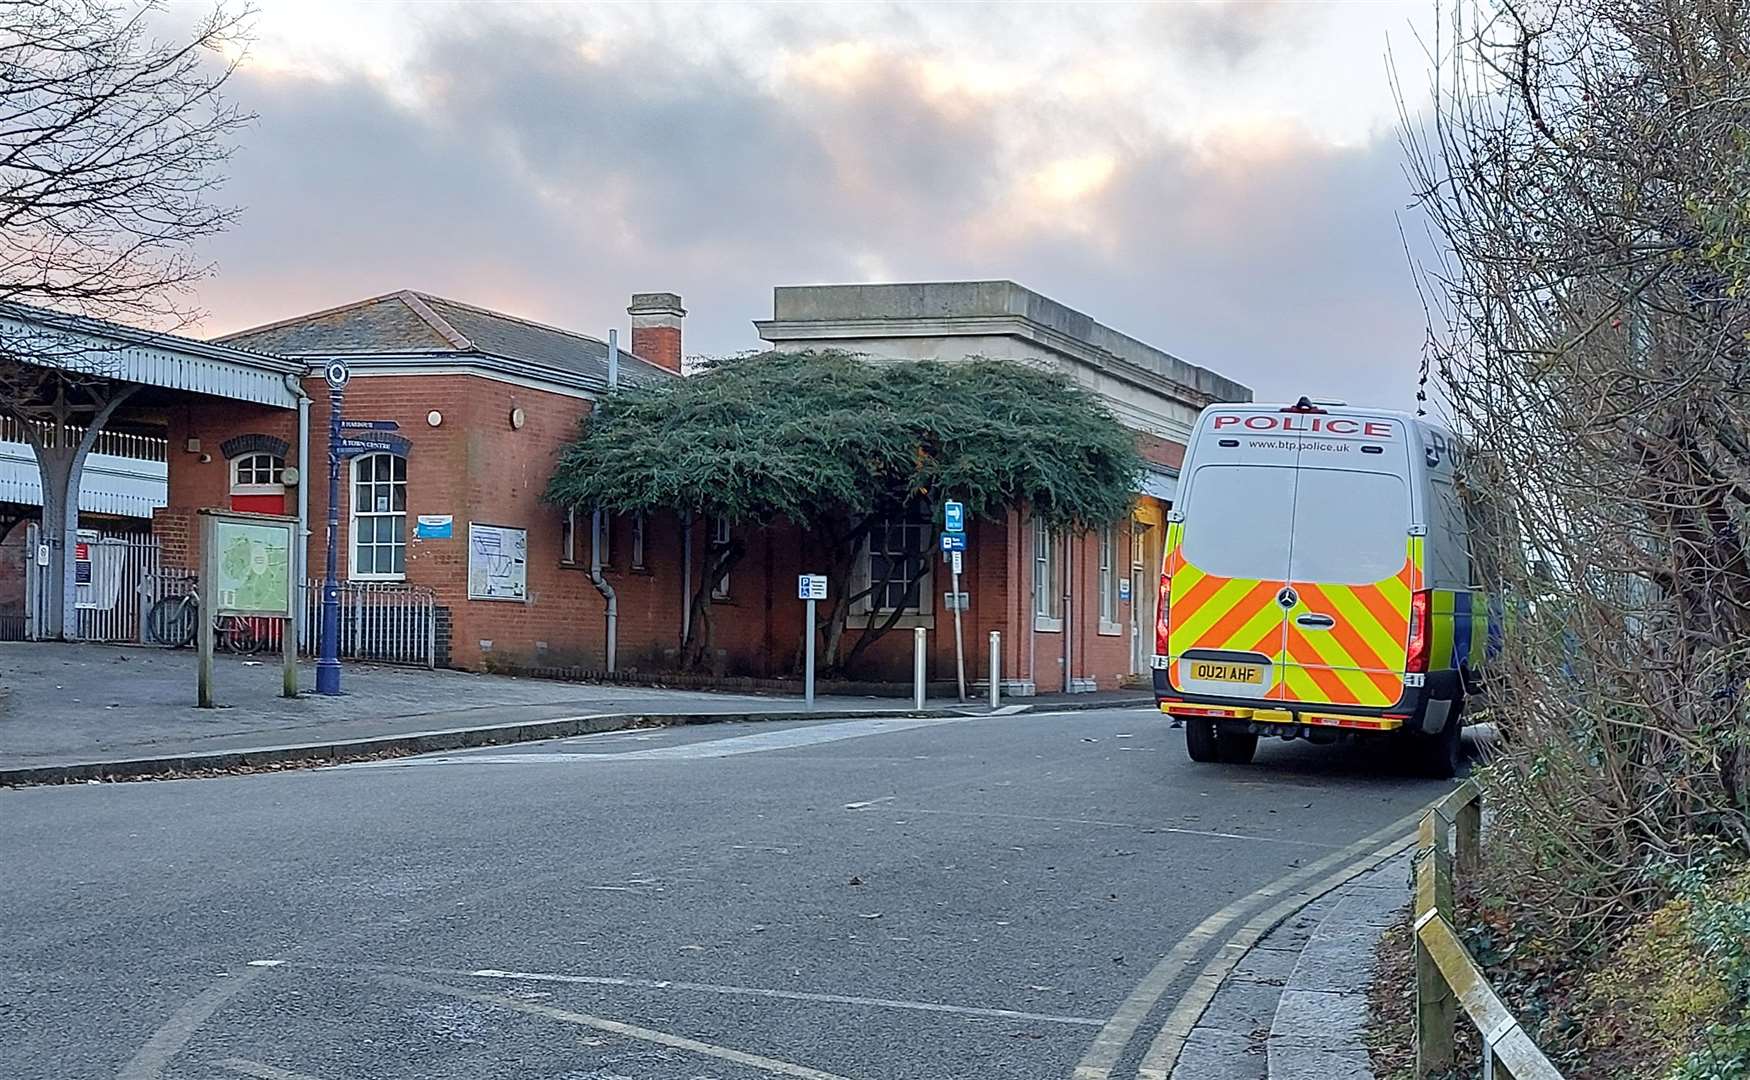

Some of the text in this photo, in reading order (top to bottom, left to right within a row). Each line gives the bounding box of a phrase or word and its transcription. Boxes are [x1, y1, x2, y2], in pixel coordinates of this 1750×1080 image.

[1214, 415, 1393, 438] POLICE
[1249, 439, 1351, 453] www.btp.police.uk
[1198, 665, 1256, 681] OU21 AHF
